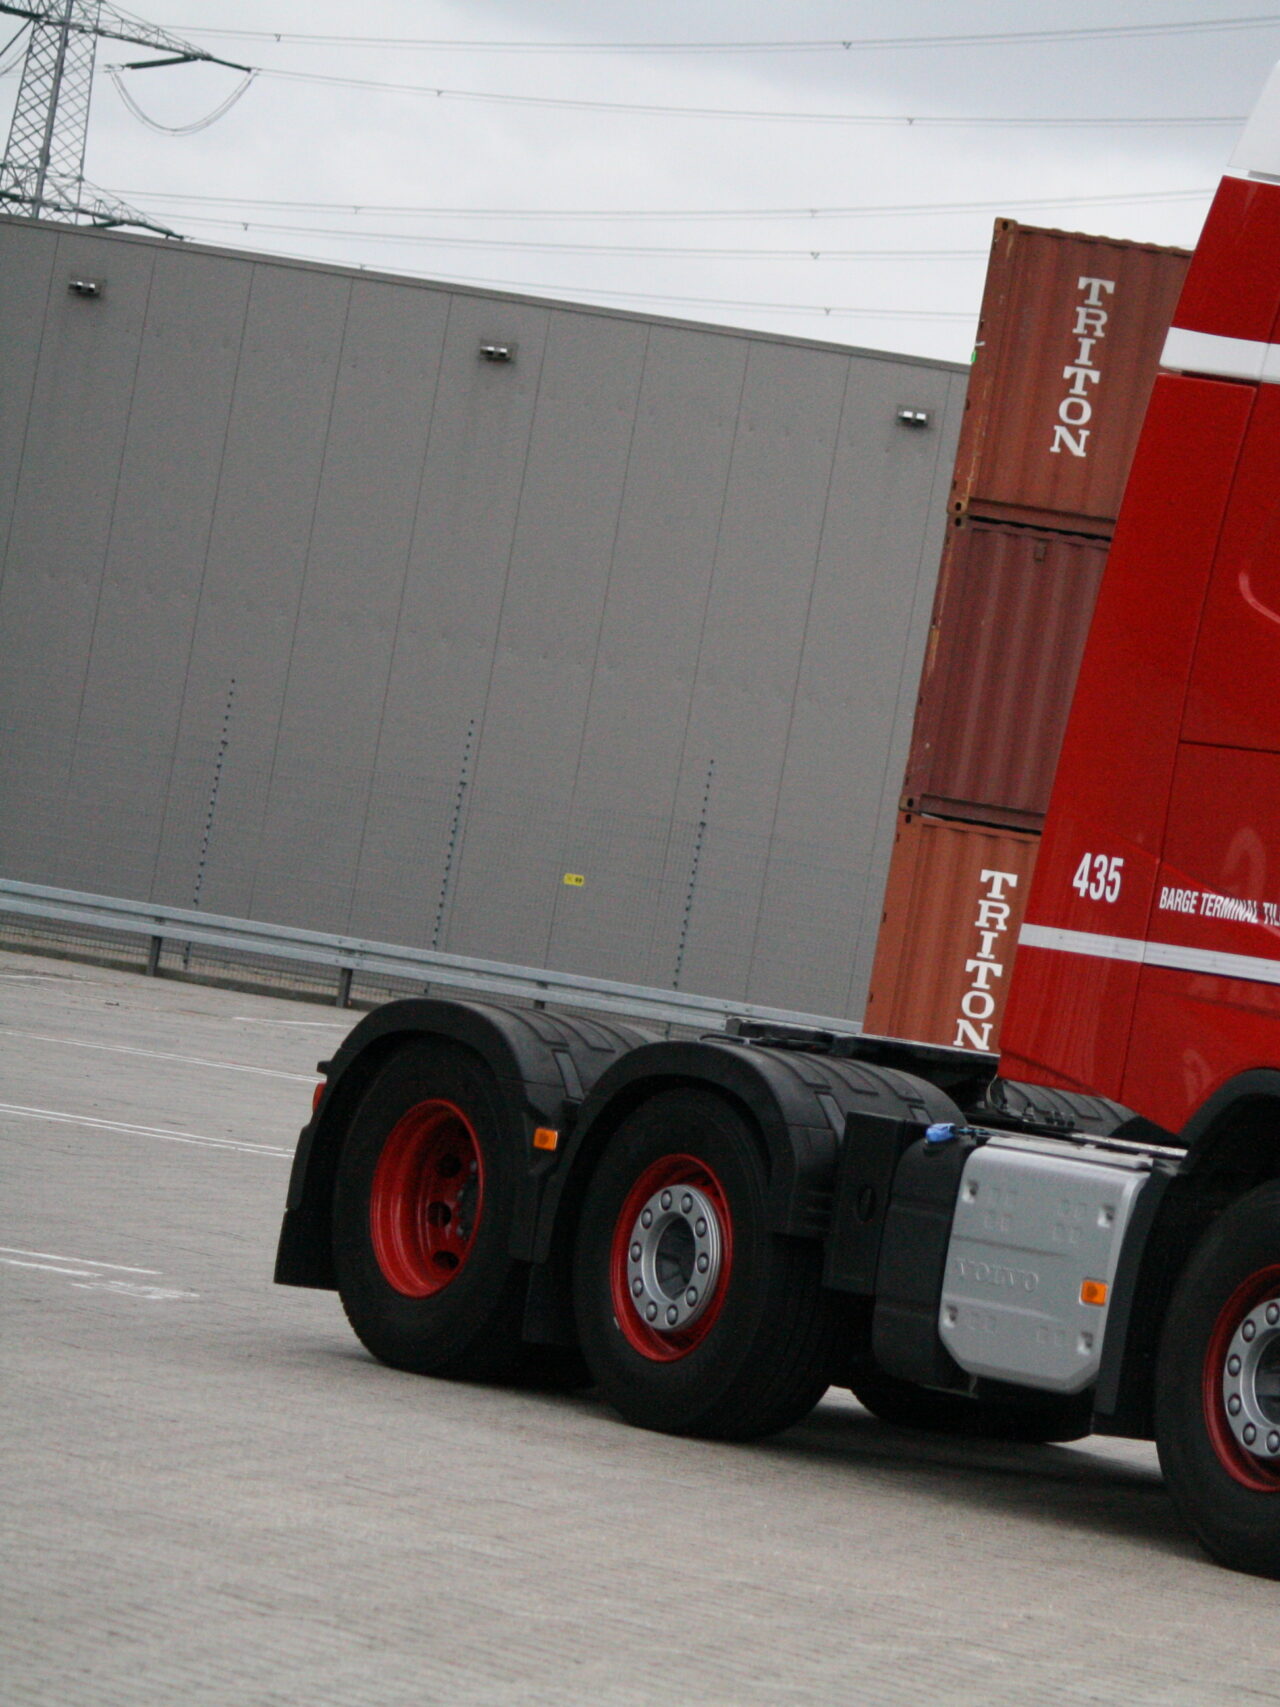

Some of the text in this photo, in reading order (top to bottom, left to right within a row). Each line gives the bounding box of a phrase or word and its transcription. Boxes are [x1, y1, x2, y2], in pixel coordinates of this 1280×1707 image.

[1050, 276, 1115, 457] TRITON
[1073, 852, 1124, 902] 435
[1159, 887, 1199, 914] BARGE
[1200, 893, 1258, 923] TERMINAL
[953, 869, 1018, 1050] TRITON
[956, 1259, 1040, 1293] VOLVO
